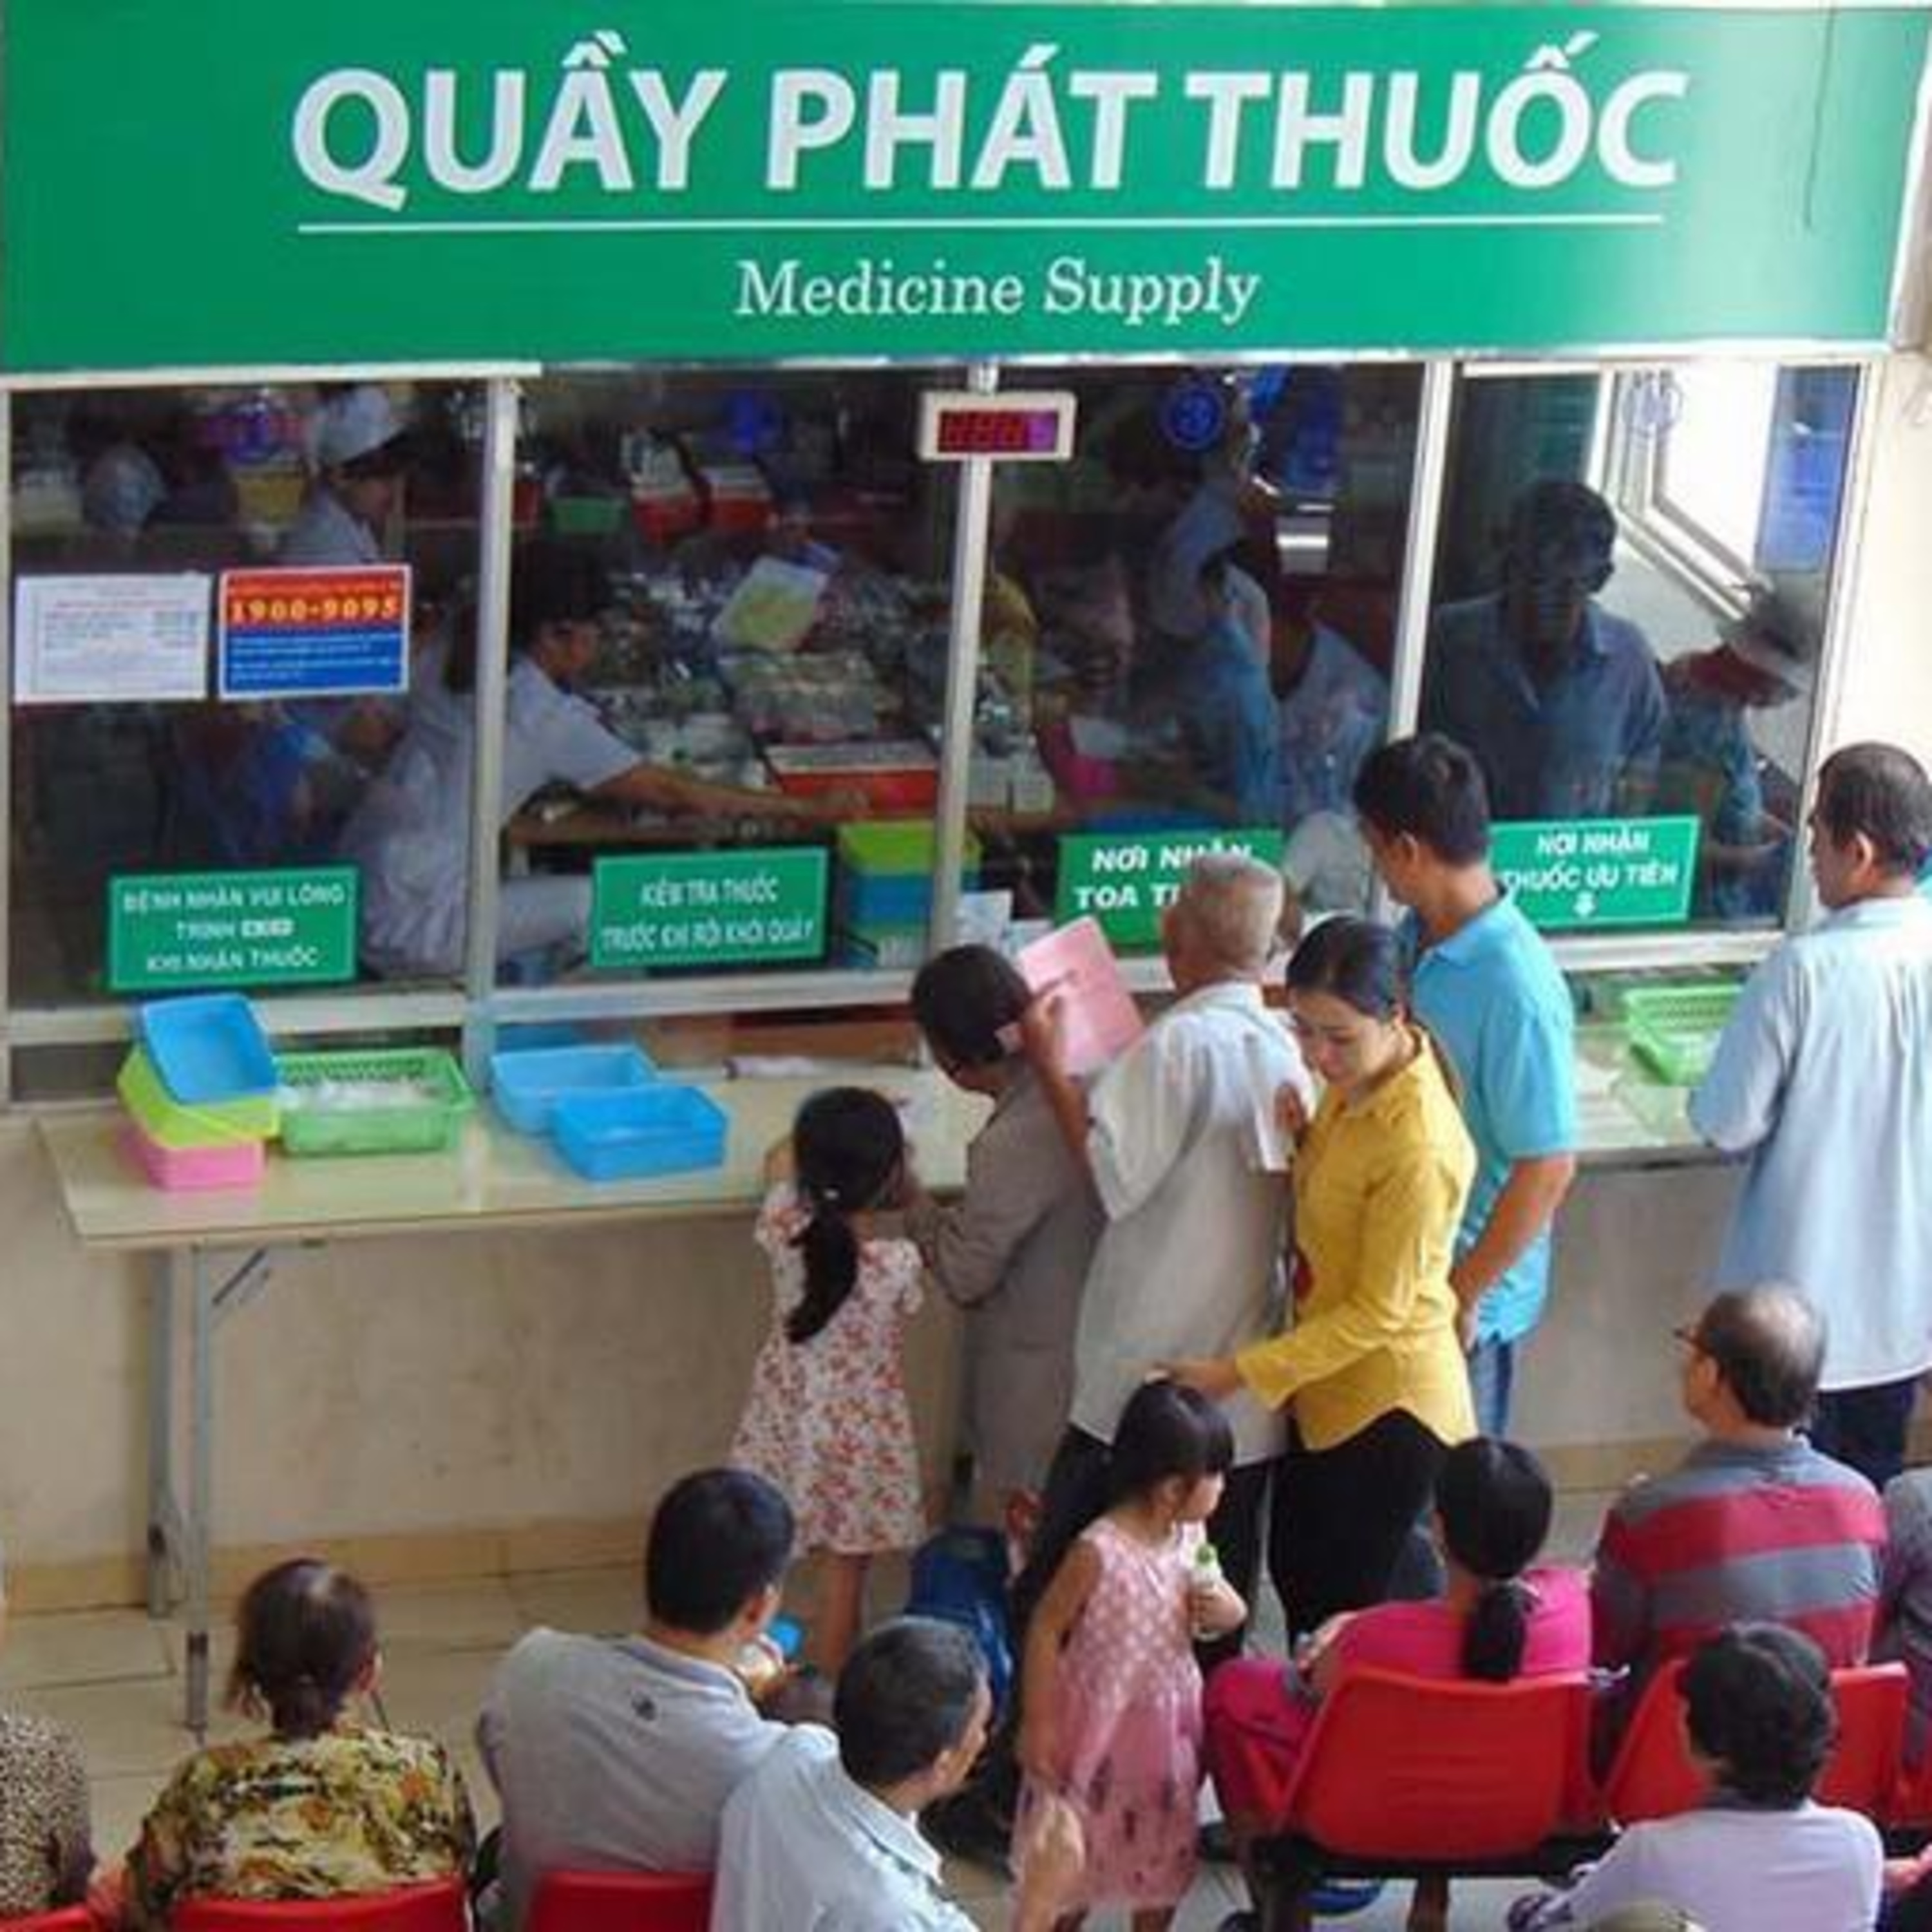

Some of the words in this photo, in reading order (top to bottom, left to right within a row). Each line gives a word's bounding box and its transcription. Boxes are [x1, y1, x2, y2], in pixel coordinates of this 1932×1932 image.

[292, 31, 726, 210] QUẦY
[766, 43, 1159, 189] PHÁT
[1184, 31, 1689, 191] THUỐC
[735, 260, 1024, 315] Medicine
[1043, 257, 1259, 325] Supply
[229, 596, 399, 624] 1900-9095
[1091, 845, 1149, 873] NƠI
[1074, 884, 1138, 909] TOA
